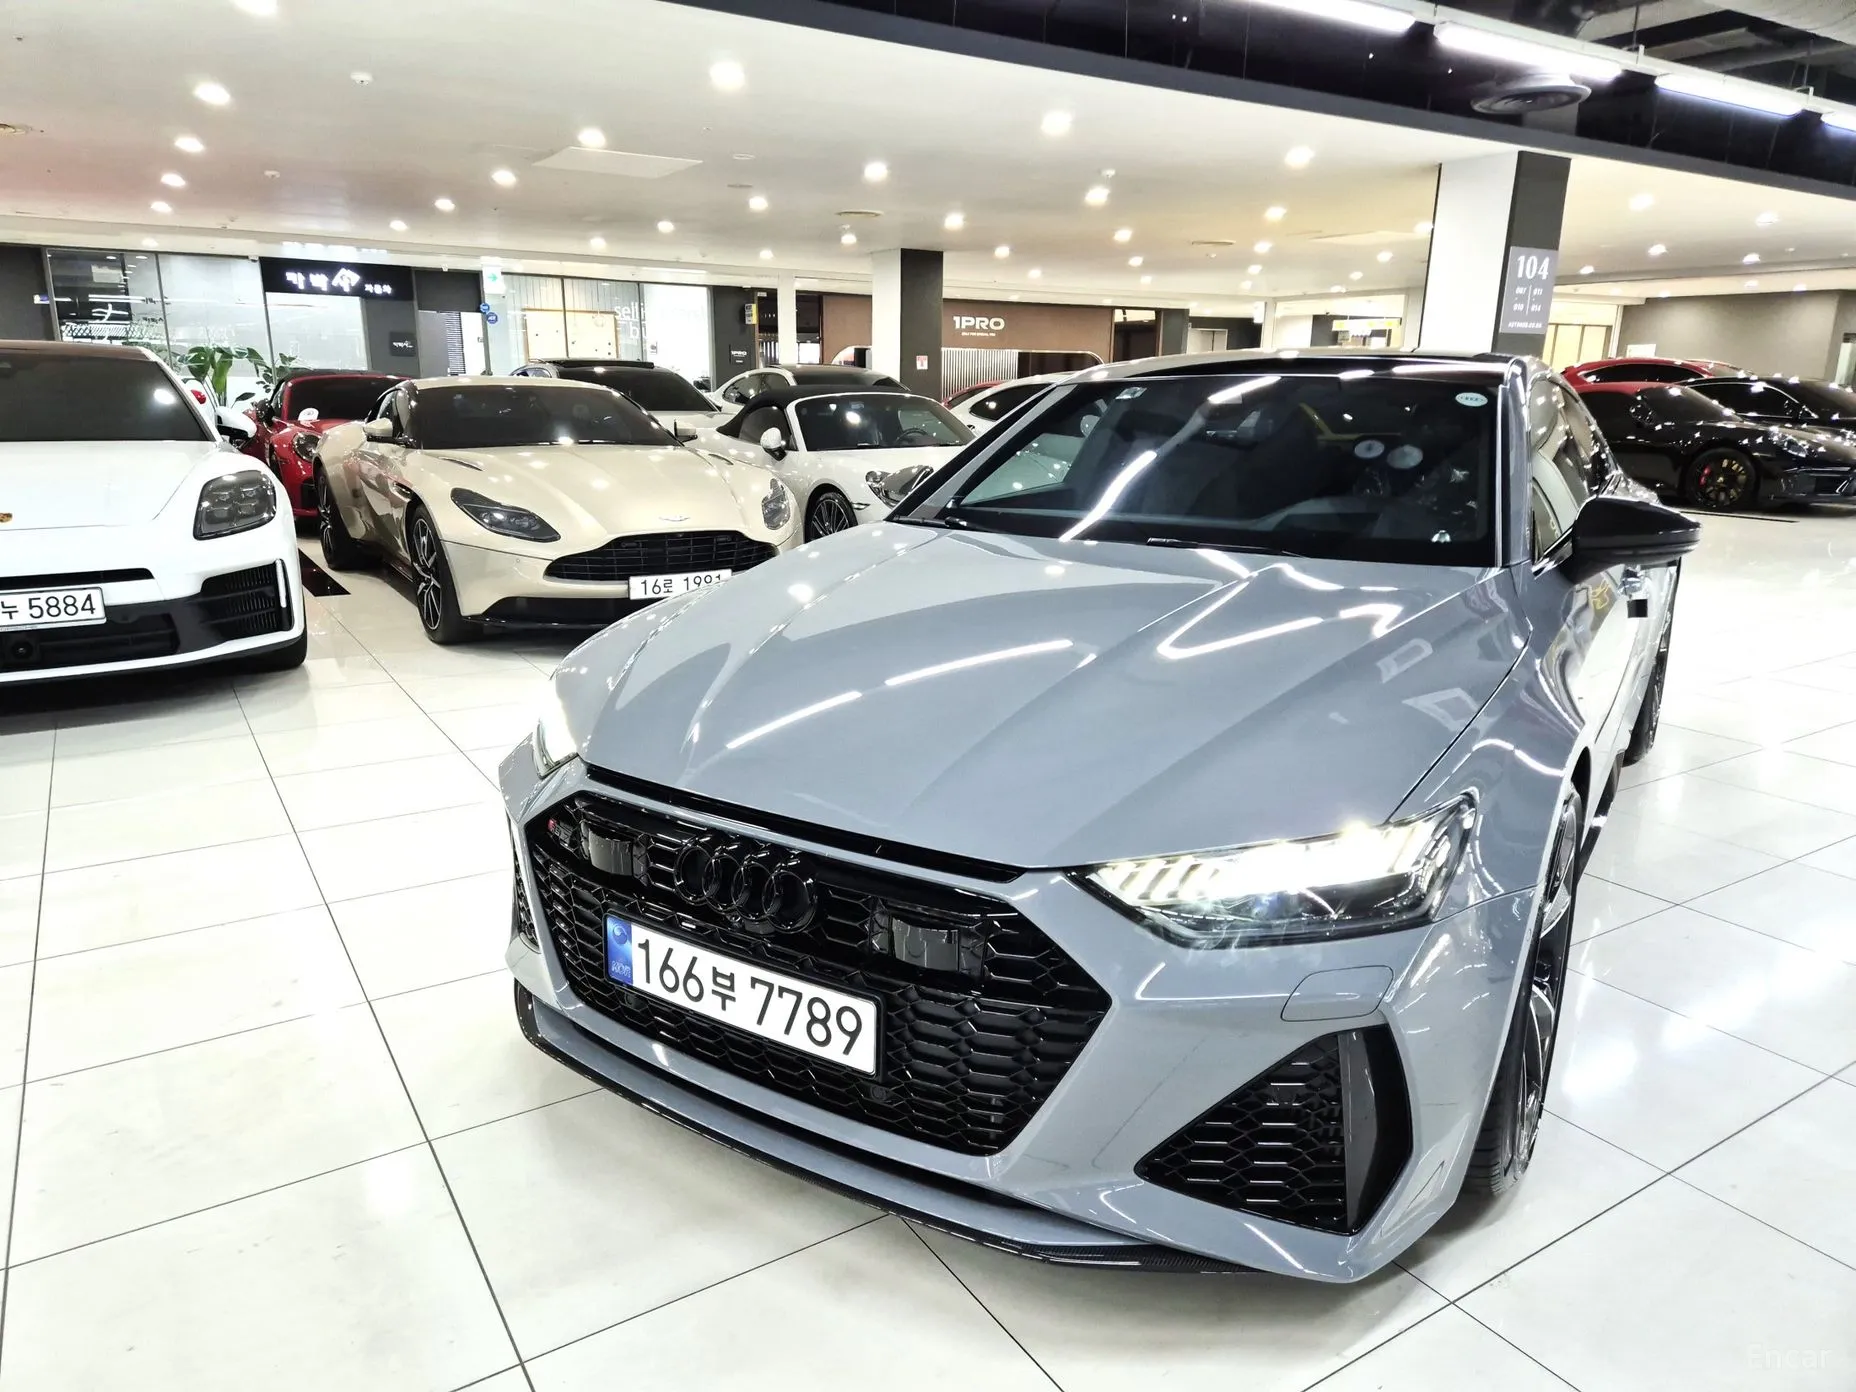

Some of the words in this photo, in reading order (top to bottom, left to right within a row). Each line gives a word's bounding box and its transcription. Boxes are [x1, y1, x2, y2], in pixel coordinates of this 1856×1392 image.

[1517, 255, 1550, 280] 104
[953, 315, 1005, 331] 1PRO
[640, 578, 673, 595] 16로
[1, 600, 19, 620] 누
[28, 593, 96, 619] 5884
[637, 938, 737, 1012] 166부
[750, 976, 863, 1056] 7789
